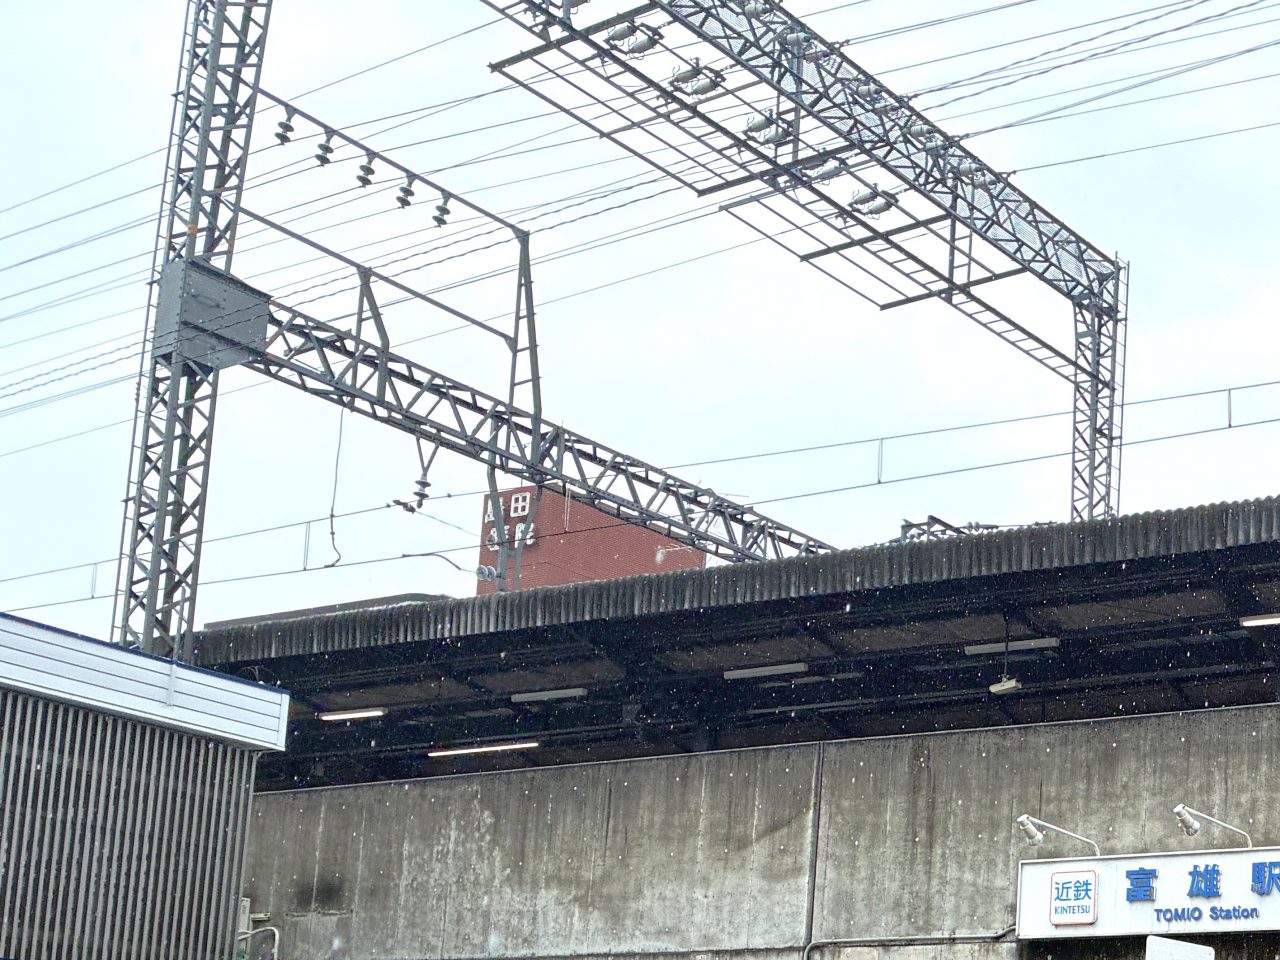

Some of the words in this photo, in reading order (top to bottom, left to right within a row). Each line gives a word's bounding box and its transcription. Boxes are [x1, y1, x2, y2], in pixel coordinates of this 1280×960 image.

[1053, 879, 1092, 902] 近鉄
[1054, 905, 1091, 915] KINTETSU
[1154, 907, 1203, 923] TOMIO
[1209, 904, 1260, 920] Station
